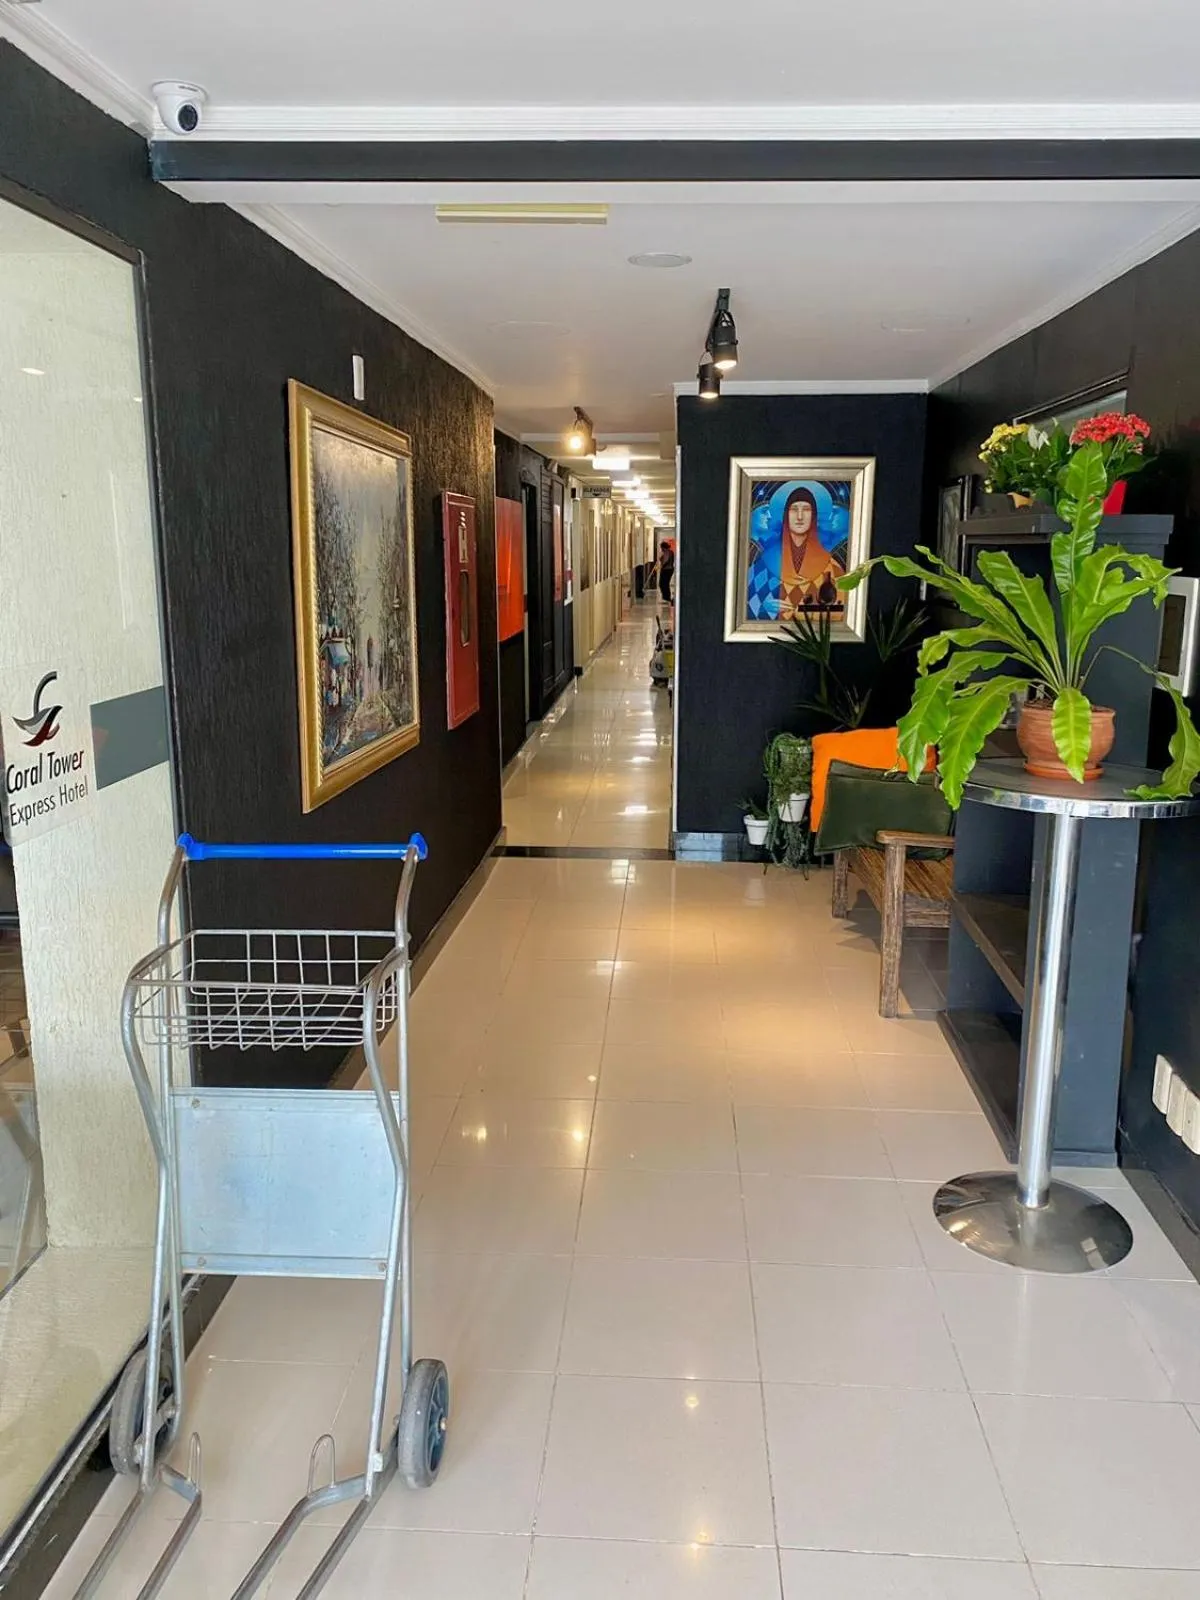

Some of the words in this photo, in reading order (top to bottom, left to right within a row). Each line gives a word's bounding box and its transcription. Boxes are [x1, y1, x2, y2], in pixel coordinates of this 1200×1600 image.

[7, 752, 43, 794] Coral
[47, 750, 85, 779] Tower
[9, 795, 56, 827] Express
[59, 775, 89, 806] Hotel
